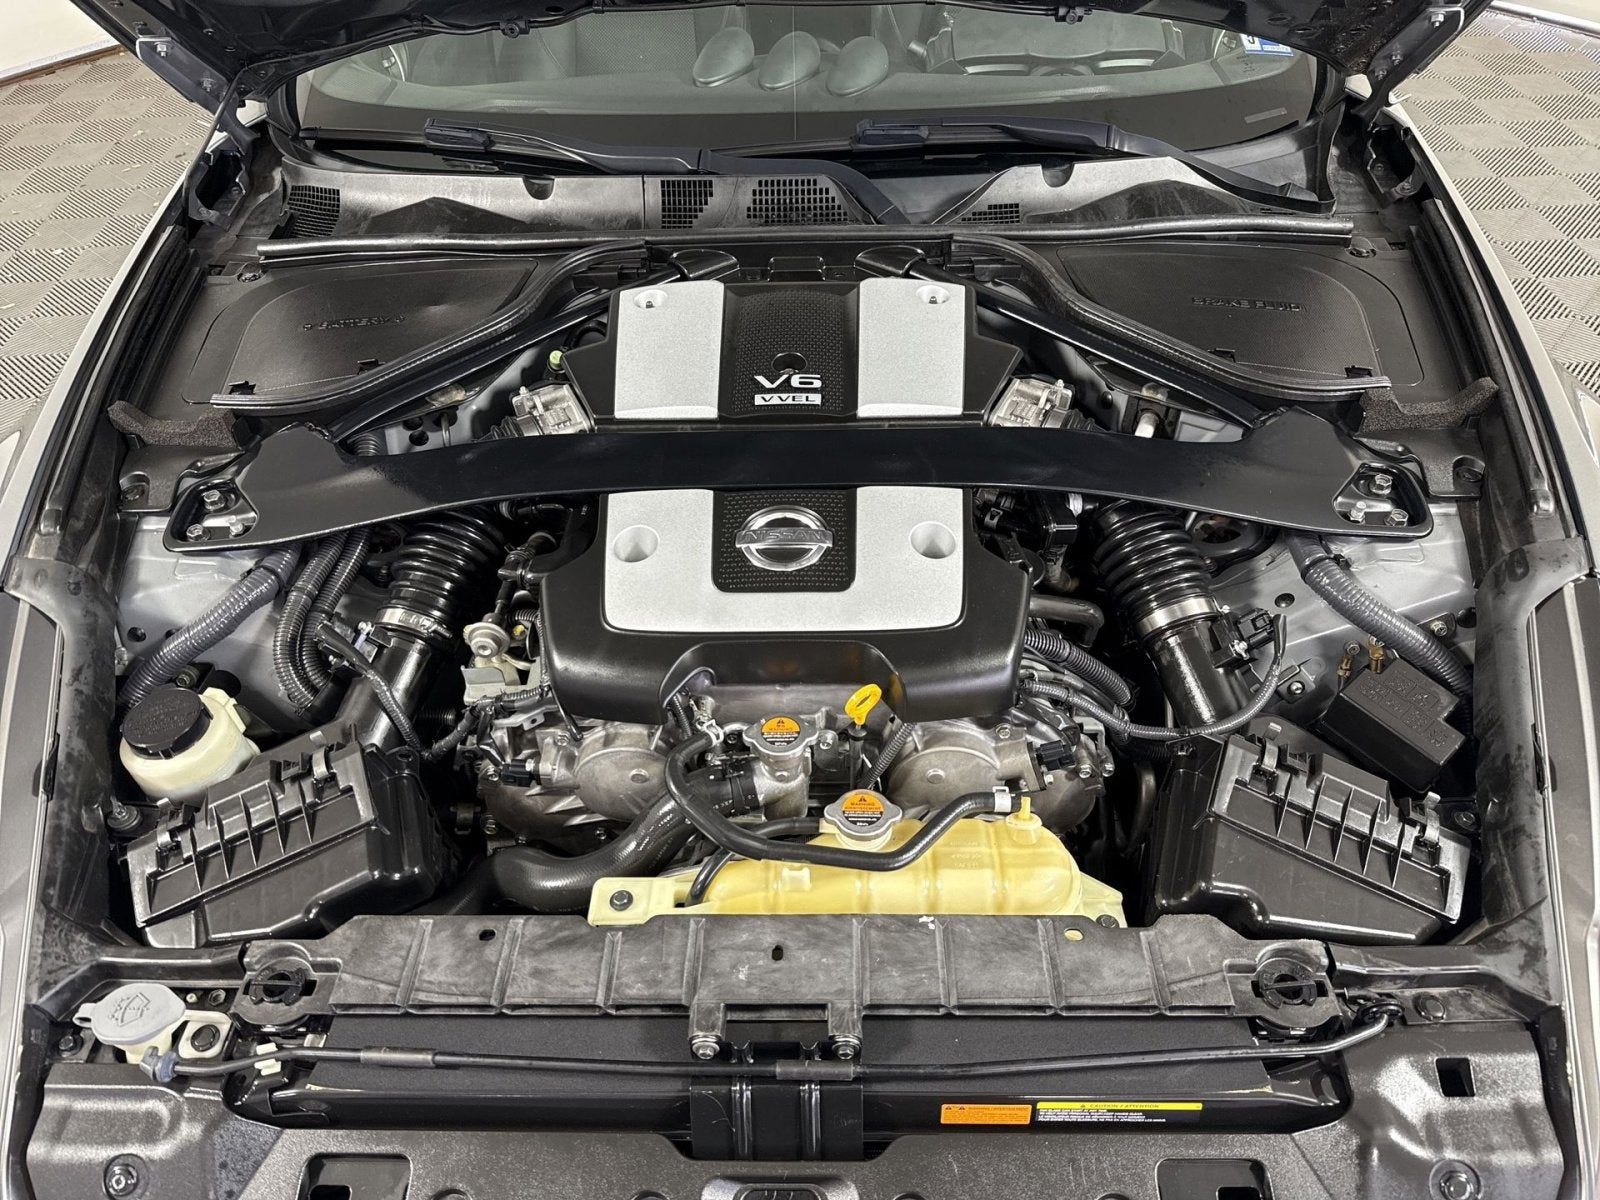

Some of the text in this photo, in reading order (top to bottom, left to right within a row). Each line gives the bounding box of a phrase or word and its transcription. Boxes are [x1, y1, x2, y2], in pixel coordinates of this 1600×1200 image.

[1192, 297, 1304, 312] BRAKE FLUID
[754, 374, 822, 388] V6
[741, 529, 826, 543] NISSAN
